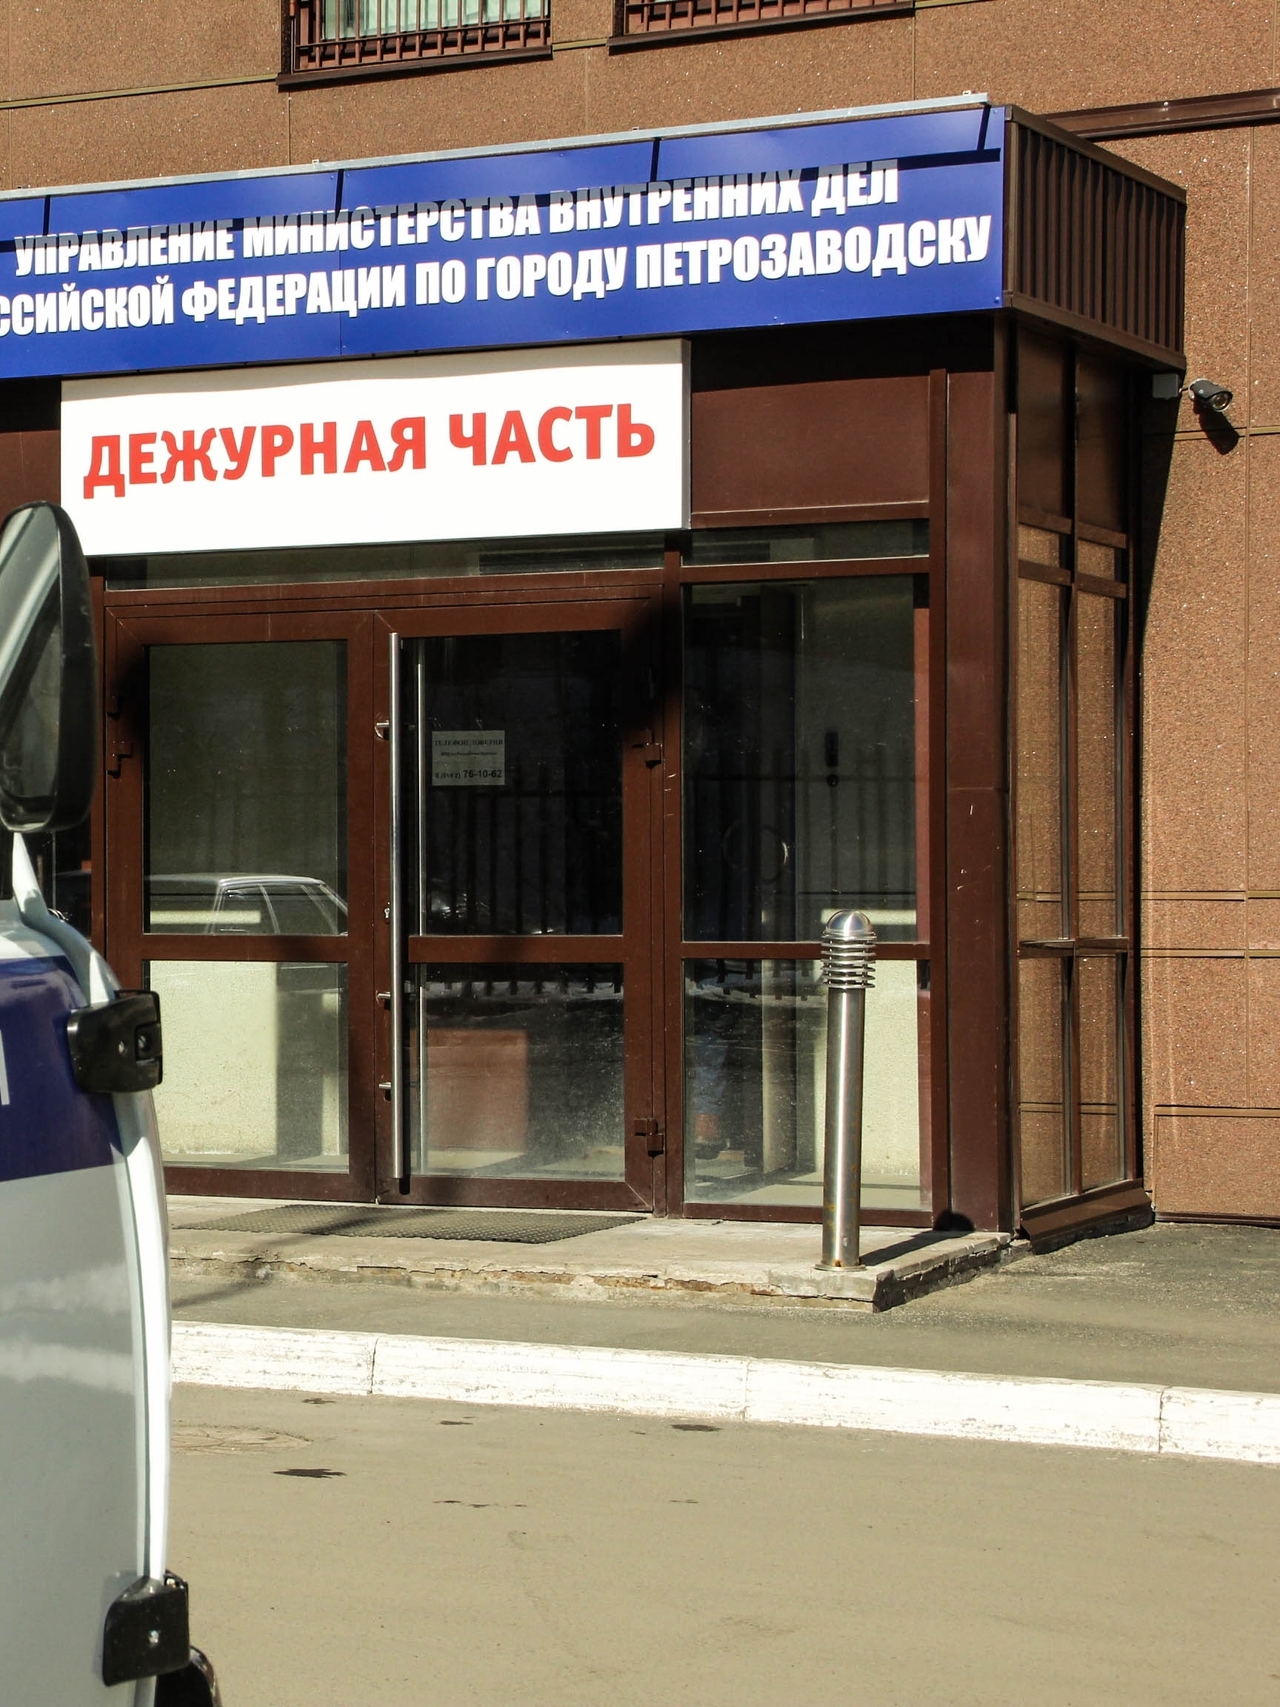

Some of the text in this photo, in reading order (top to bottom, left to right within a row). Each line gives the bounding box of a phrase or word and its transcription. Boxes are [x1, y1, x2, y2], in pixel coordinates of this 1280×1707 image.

[13, 158, 899, 277] УПРАВЛЕНИЕ МИНИСТЕРСТВА ВНУТРЕННИХ ДЕЛ
[181, 263, 407, 326] ФЕДЕРАЦИИ
[414, 259, 467, 306] ПО
[475, 246, 628, 301] ГОРОДУ
[636, 215, 992, 290] ПЕТРОЗАВОДСКУ
[82, 403, 656, 499] ДЕЖУРНАЯ ЧАСТЬ
[462, 769, 503, 779] 76-10-62
